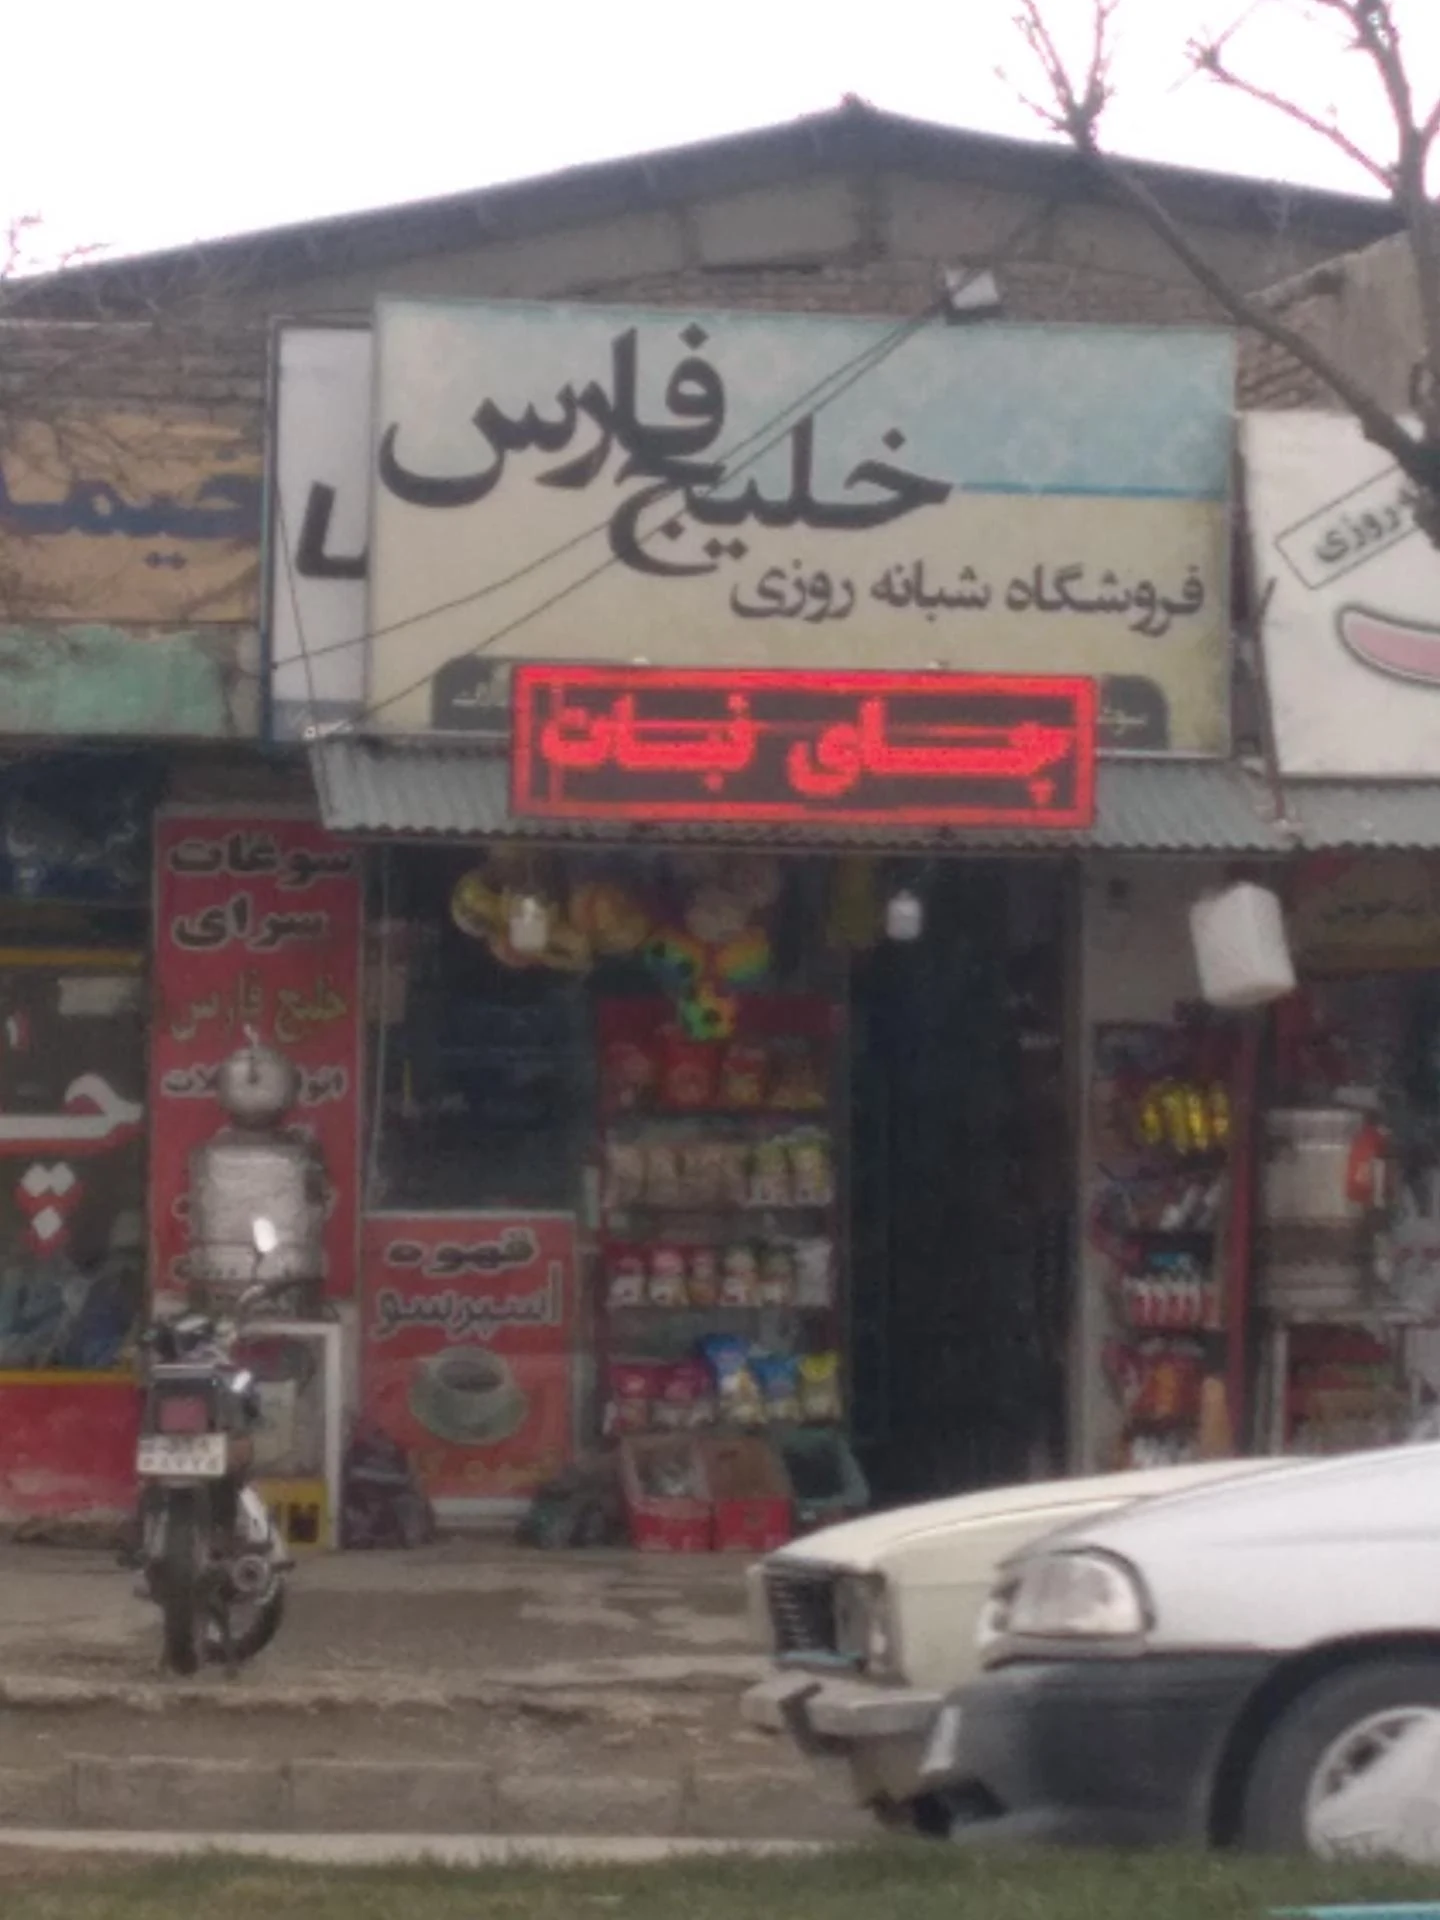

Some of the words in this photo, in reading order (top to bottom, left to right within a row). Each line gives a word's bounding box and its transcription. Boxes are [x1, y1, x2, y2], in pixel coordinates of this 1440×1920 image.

[380, 322, 727, 508] فارس
[609, 413, 953, 576] خلیج
[730, 557, 856, 623] روزی
[869, 559, 993, 623] شبانه
[1005, 563, 1206, 637] فروشگاه
[540, 692, 759, 794] نبات
[786, 696, 1072, 806] چای
[167, 829, 360, 889] سوغات
[171, 890, 330, 953] سرای
[170, 967, 265, 1044] فارس
[274, 973, 348, 1044] خلیج
[386, 1227, 539, 1278] قهوه
[369, 1260, 563, 1340] اسپرسو
